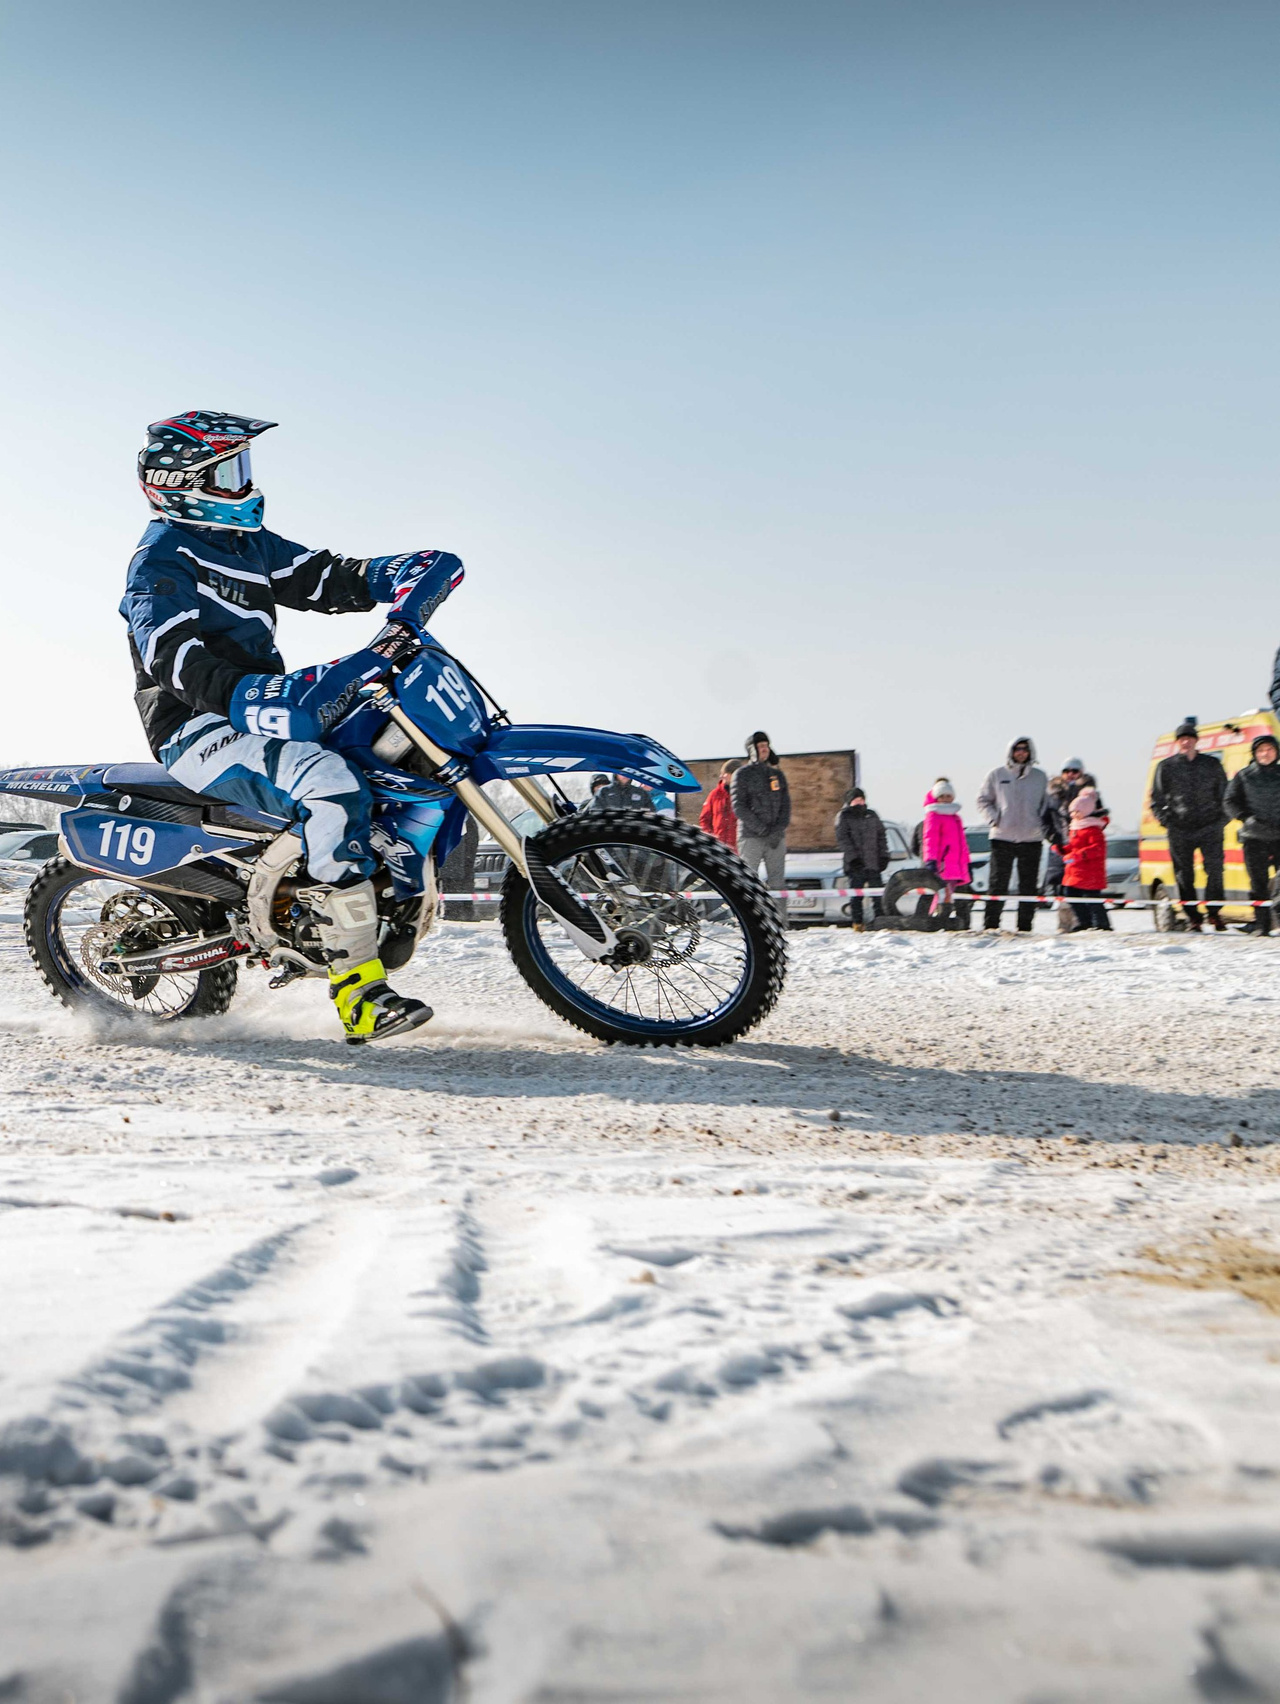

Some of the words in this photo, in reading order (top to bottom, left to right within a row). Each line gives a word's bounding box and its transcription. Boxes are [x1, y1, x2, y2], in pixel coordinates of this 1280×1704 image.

[145, 469, 206, 488] 100%
[425, 666, 472, 722] 119
[199, 732, 245, 765] YAM
[6, 782, 70, 793] MICHELIN
[99, 820, 156, 866] 119
[162, 947, 227, 970] RENTHAL
